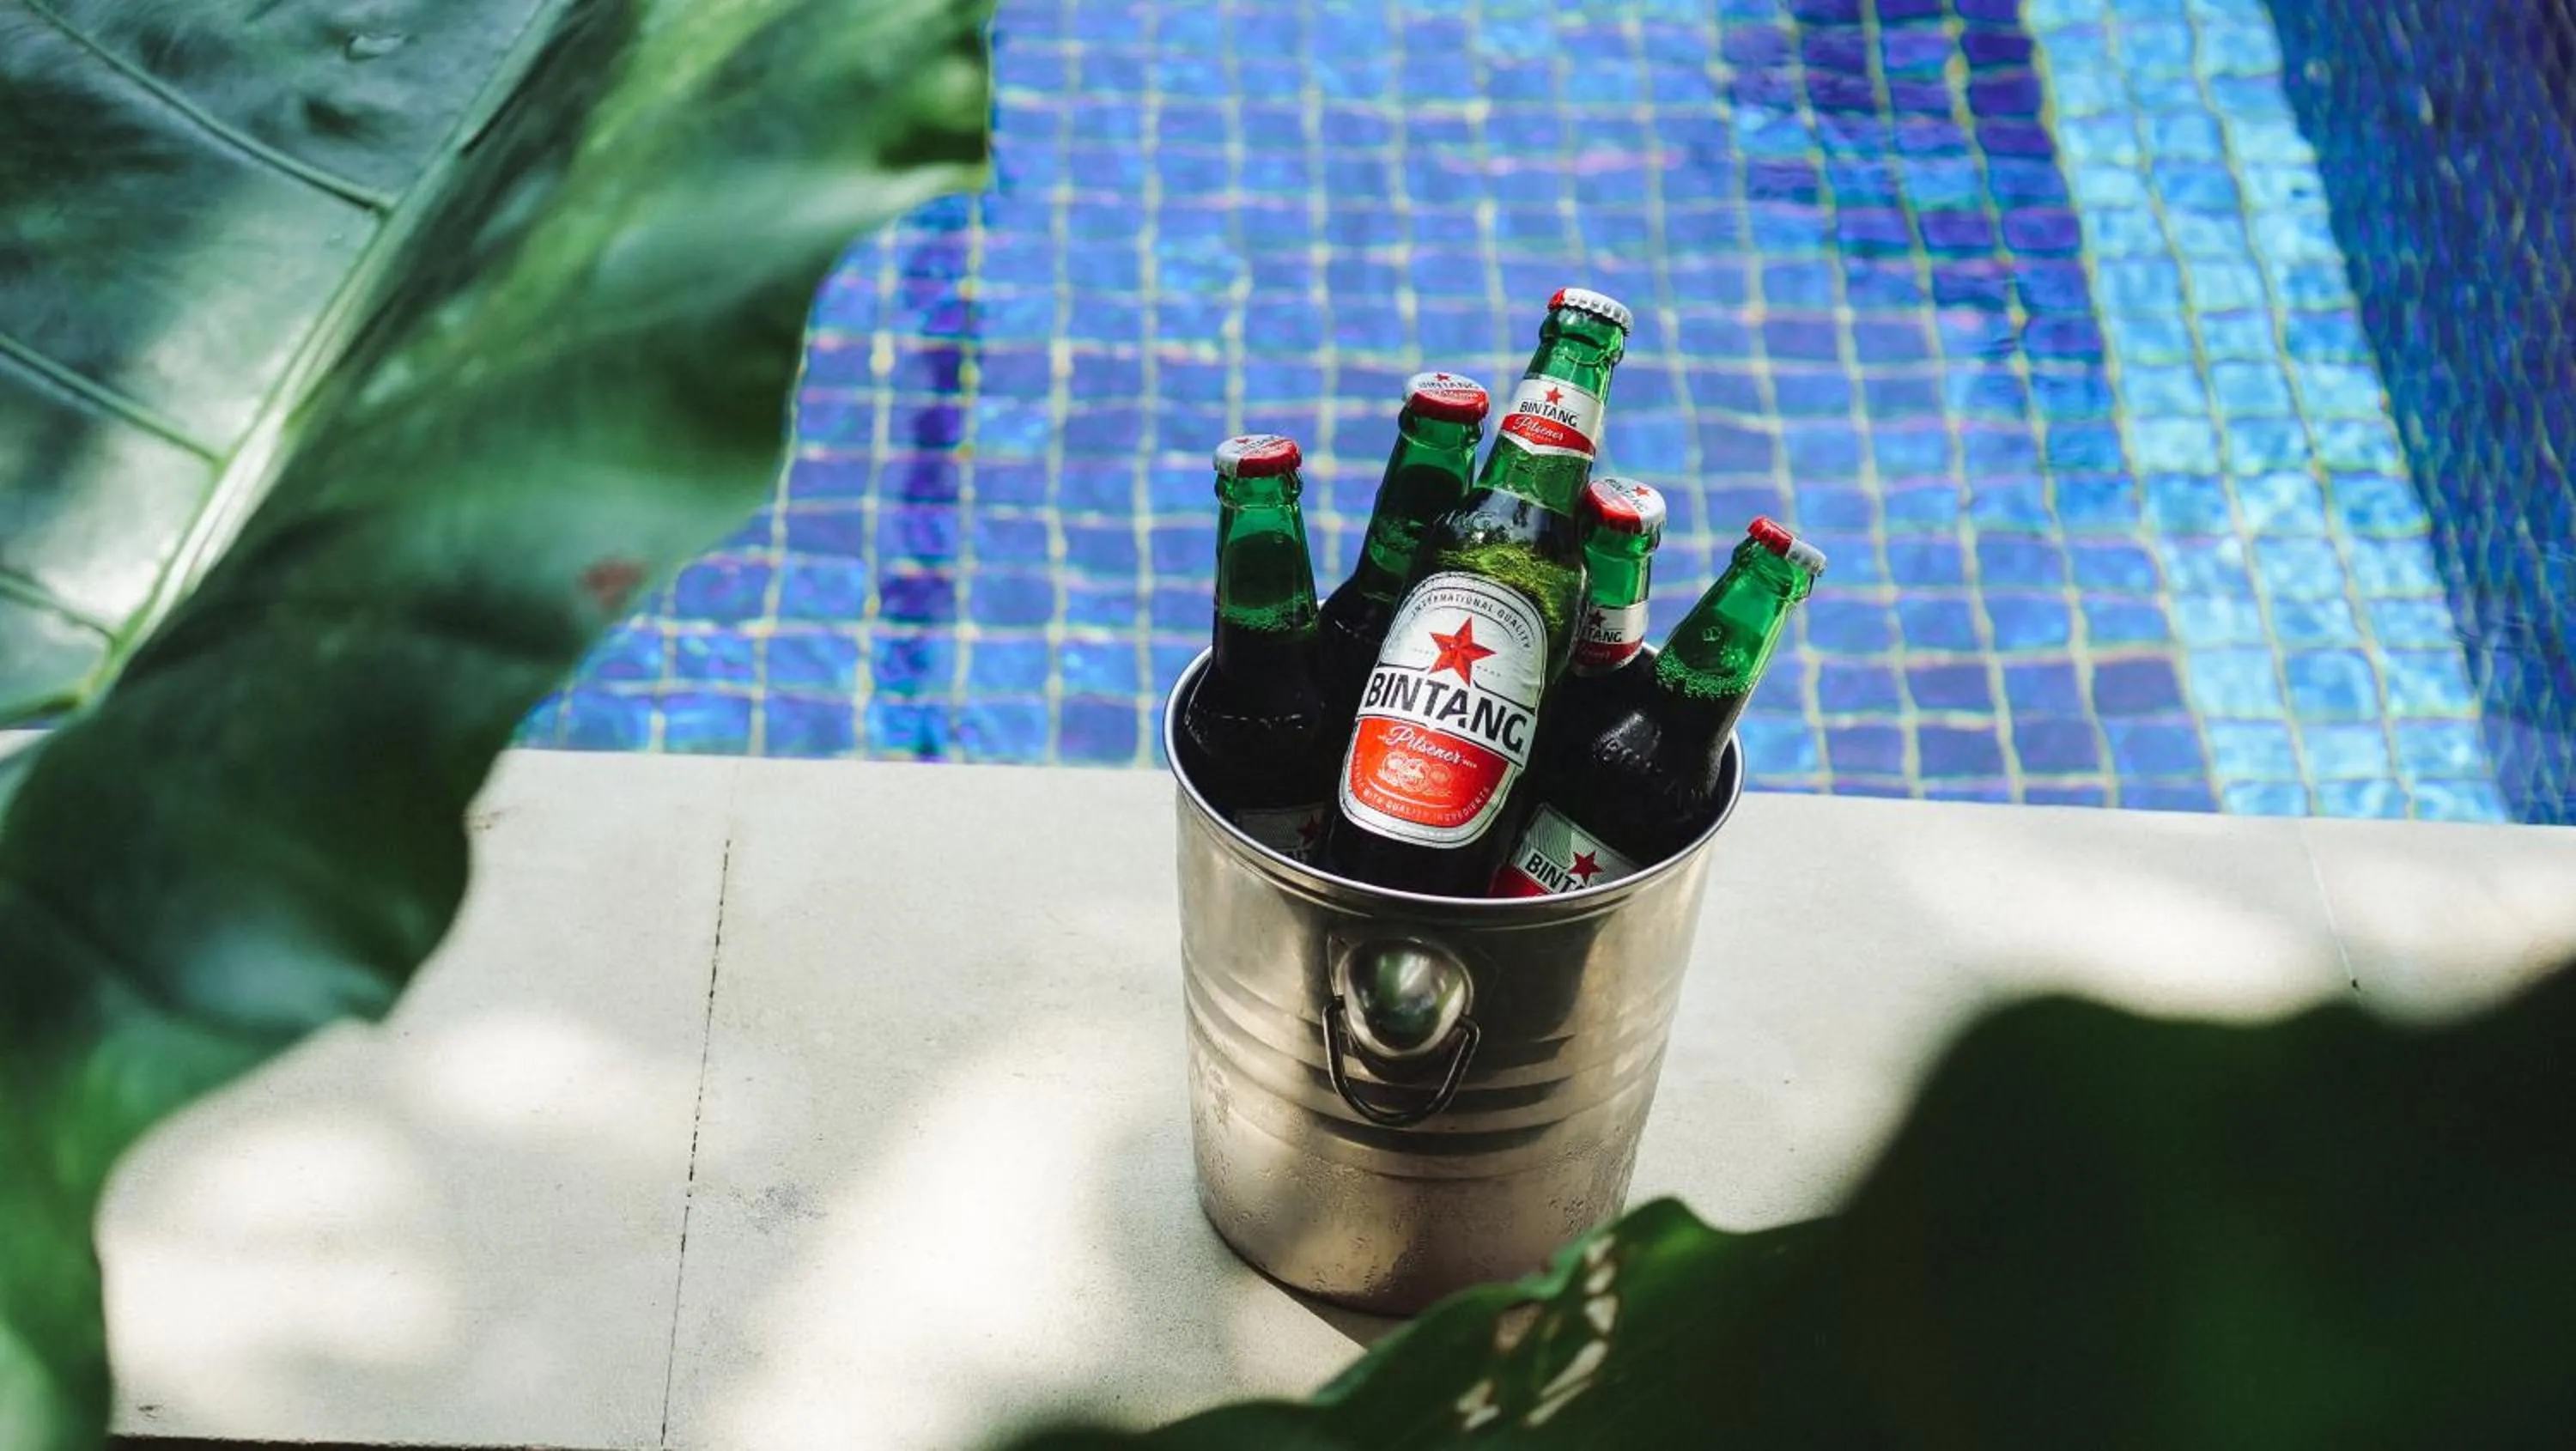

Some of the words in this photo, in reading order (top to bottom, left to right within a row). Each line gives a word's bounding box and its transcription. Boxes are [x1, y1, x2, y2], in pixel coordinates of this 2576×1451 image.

[1519, 400, 1578, 428] BINTANG
[1497, 609, 1531, 649] QUALITY
[1364, 672, 1527, 754] BINTANG
[1384, 726, 1461, 766] Pilsener
[1524, 852, 1585, 893] BINT
